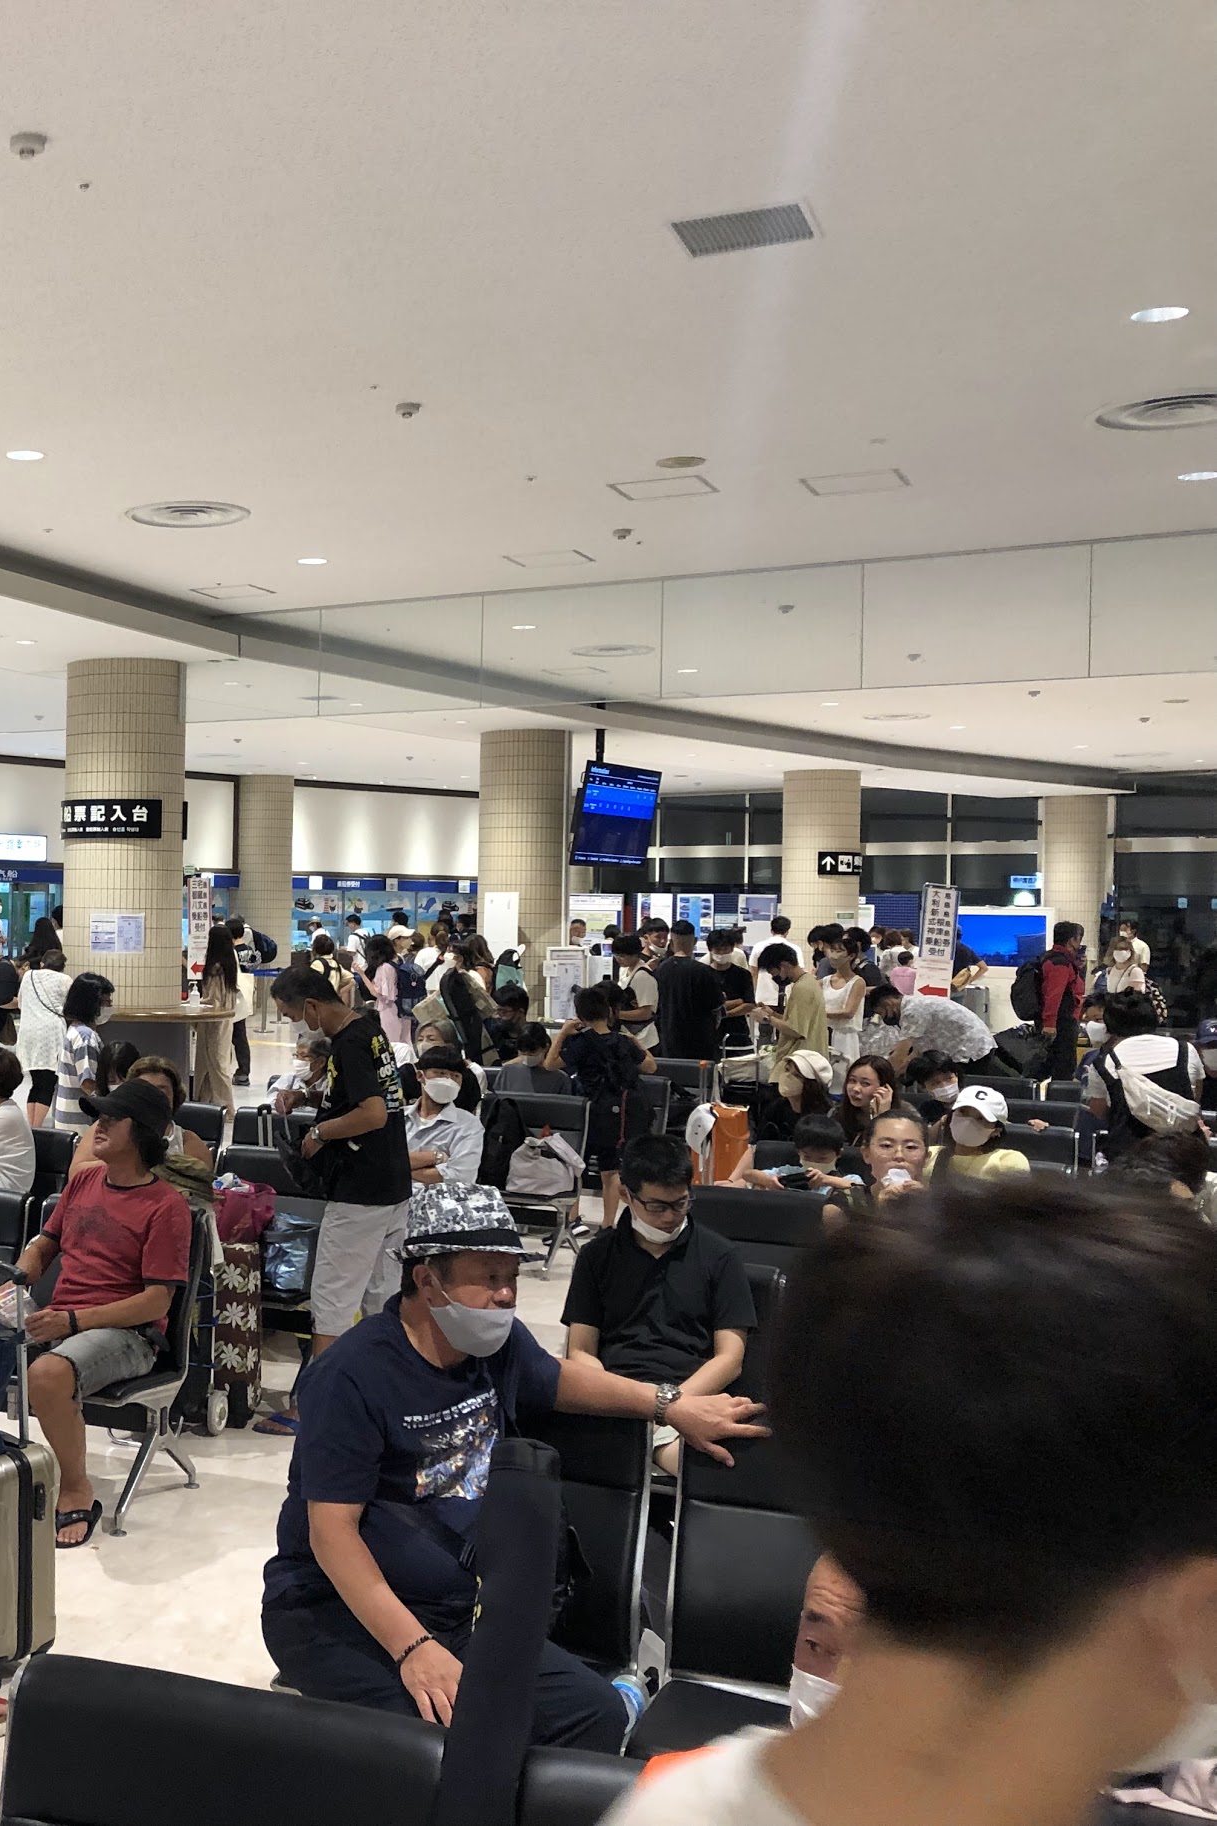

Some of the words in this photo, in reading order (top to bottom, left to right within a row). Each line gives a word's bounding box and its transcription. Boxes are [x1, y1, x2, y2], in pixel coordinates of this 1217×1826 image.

[61, 805, 149, 822] 船票記入台
[192, 901, 208, 910] 八丈島
[194, 922, 206, 933] 受付
[928, 948, 945, 957] 受付
[975, 1090, 988, 1101] C
